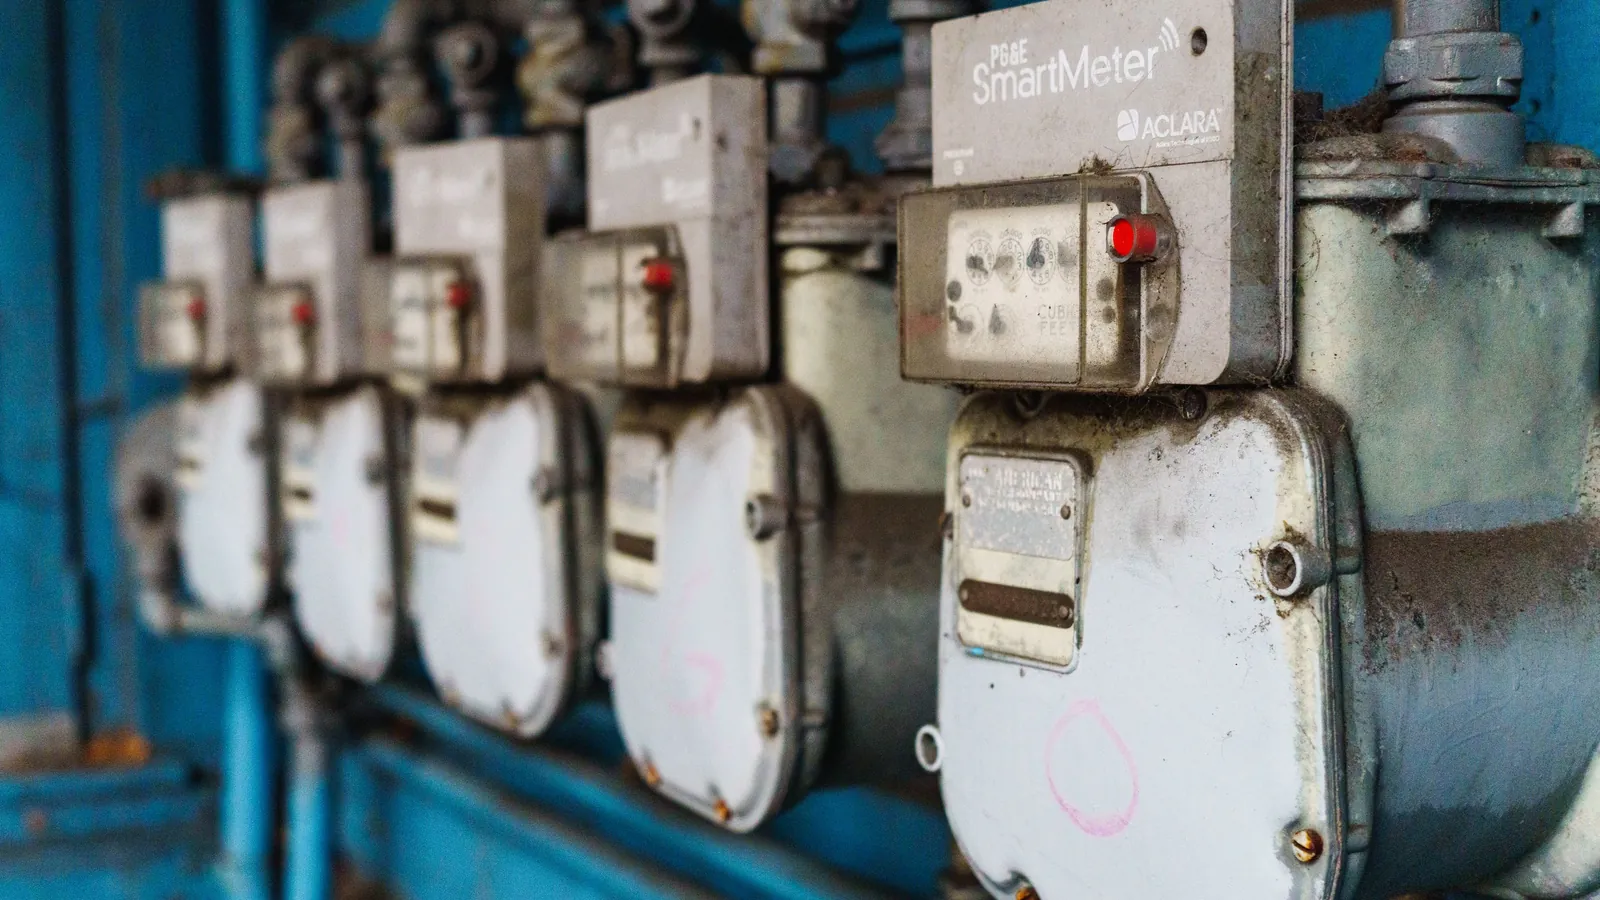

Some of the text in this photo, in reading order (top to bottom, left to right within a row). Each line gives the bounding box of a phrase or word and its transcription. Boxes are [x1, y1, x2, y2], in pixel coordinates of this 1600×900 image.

[990, 38, 1028, 69] PG&E
[972, 45, 1159, 105] SmartMeter
[1141, 109, 1220, 140] ACLARA
